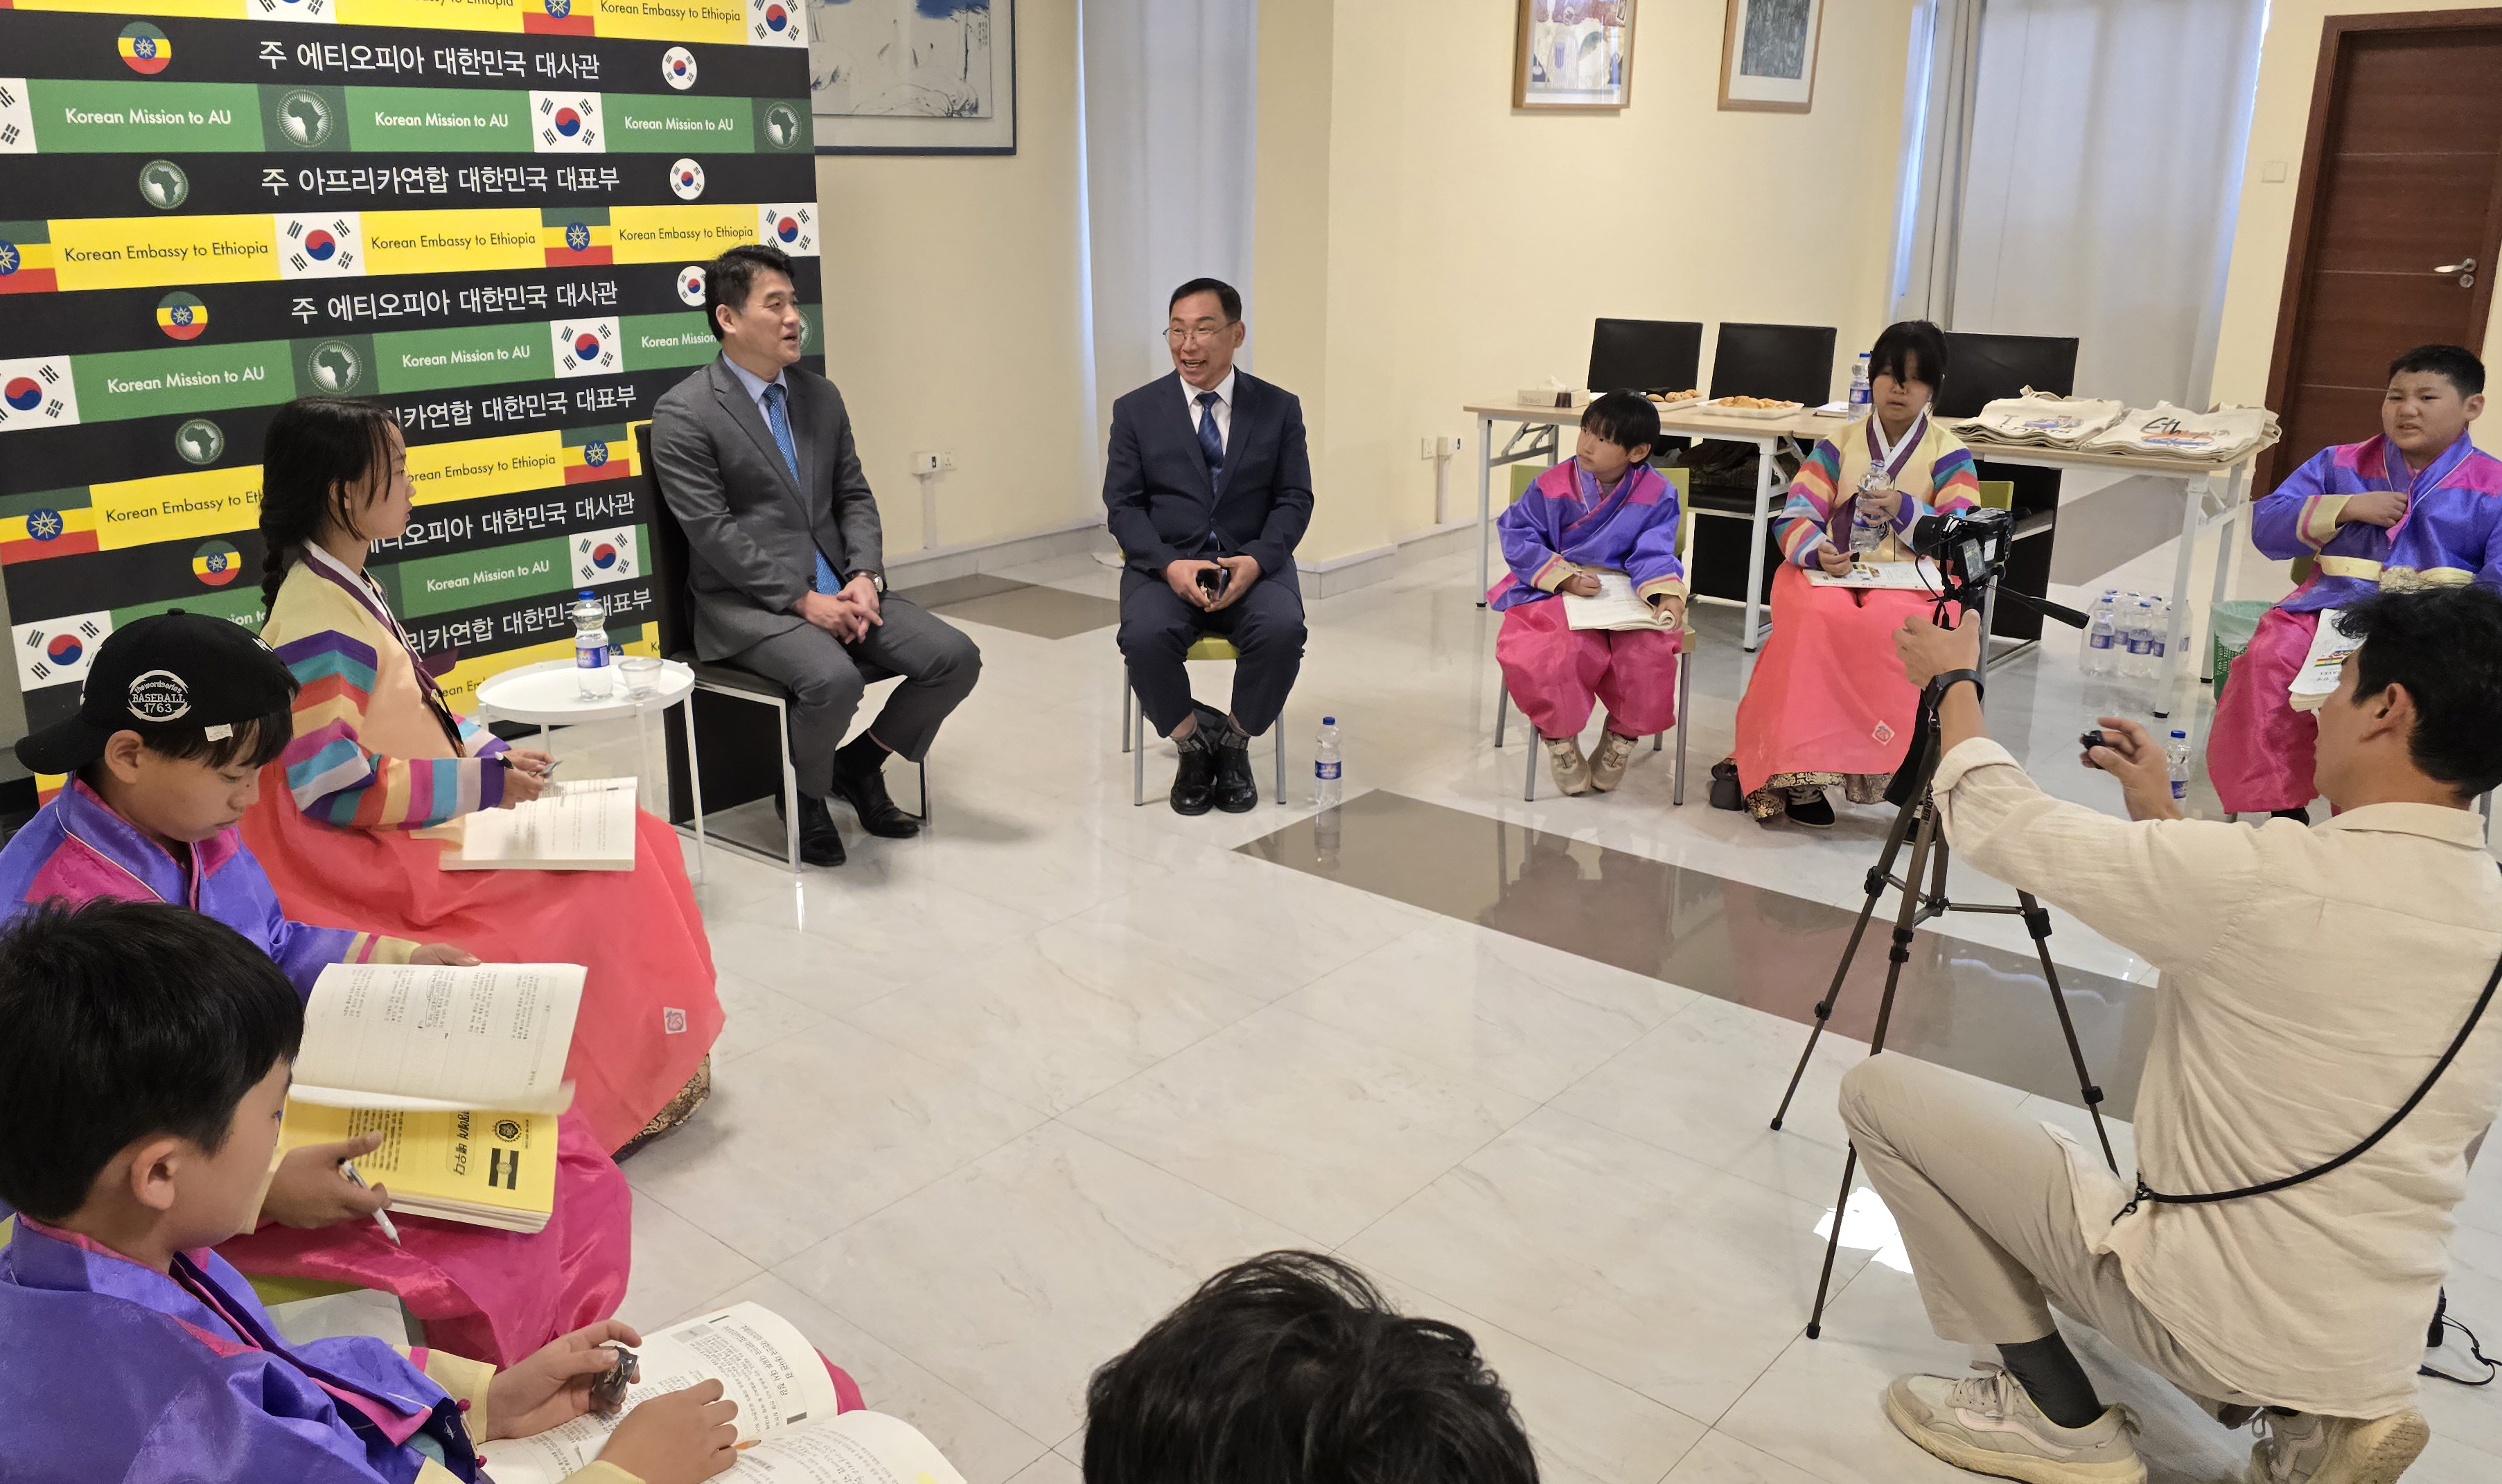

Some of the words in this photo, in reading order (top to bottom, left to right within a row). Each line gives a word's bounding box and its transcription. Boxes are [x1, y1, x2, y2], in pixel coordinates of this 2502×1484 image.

[467, 0, 513, 9] iopia
[601, 0, 639, 15] Korean
[642, 2, 686, 21] Embassy
[689, 8, 698, 18] to
[701, 6, 740, 24] Ethiopia
[258, 41, 288, 70] 주
[297, 42, 425, 74] 에티오피아
[434, 47, 527, 78] 대한민국
[535, 52, 600, 80] 대사관
[65, 107, 124, 124] Korean
[129, 109, 185, 124] Mission
[188, 111, 204, 125] to
[208, 109, 231, 125] AU
[375, 112, 422, 126] Korean
[425, 112, 471, 127] Mission
[473, 114, 486, 127] to
[488, 113, 509, 127] AU
[624, 116, 662, 130] Korean
[665, 117, 703, 130] Mission
[705, 119, 716, 131] to
[717, 118, 734, 131] AU
[261, 168, 290, 196] 주
[299, 166, 450, 195] 아프리카연합
[458, 166, 548, 193] 대한민국
[556, 166, 620, 192] 대표부
[371, 236, 416, 249] Korean
[420, 233, 472, 250] Embassy
[475, 235, 486, 245] to
[490, 231, 536, 248] Ethiopia
[619, 229, 656, 240] Korean
[658, 227, 701, 242] Embassy
[703, 228, 713, 238] to
[716, 225, 753, 240] Ethiopia
[64, 247, 121, 261] Korean
[126, 243, 188, 261] Embassy
[193, 245, 207, 256] to
[212, 240, 268, 258] Ethiopia
[291, 297, 318, 324] 주
[327, 289, 451, 321] 에티오피아
[459, 285, 548, 313] 대한민국
[556, 280, 618, 308] 대사관
[642, 335, 679, 348] Korean
[682, 331, 716, 345] Mission
[402, 354, 447, 368] Korean
[450, 350, 495, 364] Mission
[496, 348, 509, 360] to
[511, 344, 530, 359] AU
[107, 378, 161, 394] Korean
[166, 371, 221, 388] Mission
[224, 371, 238, 383] to
[243, 366, 265, 381] AU
[387, 400, 473, 430] 카연합
[482, 393, 569, 423] 대한민국
[576, 385, 637, 414] 대표부
[410, 471, 441, 482] orean
[446, 463, 493, 478] Embassy
[497, 460, 509, 471] to
[511, 454, 556, 472] Ethiopia
[106, 507, 157, 523] Korean
[162, 498, 224, 514] Embassy
[228, 495, 241, 506] to
[482, 504, 567, 534] 대한민국
[575, 492, 635, 520] 대사관
[427, 577, 470, 592] Korean
[473, 569, 515, 584] Mission
[518, 566, 529, 576] to
[531, 559, 549, 574] AU
[407, 617, 493, 653] 리카연합
[132, 694, 185, 703] BASEBALL
[144, 703, 172, 713] 1763
[454, 1143, 468, 1176] 배우다
